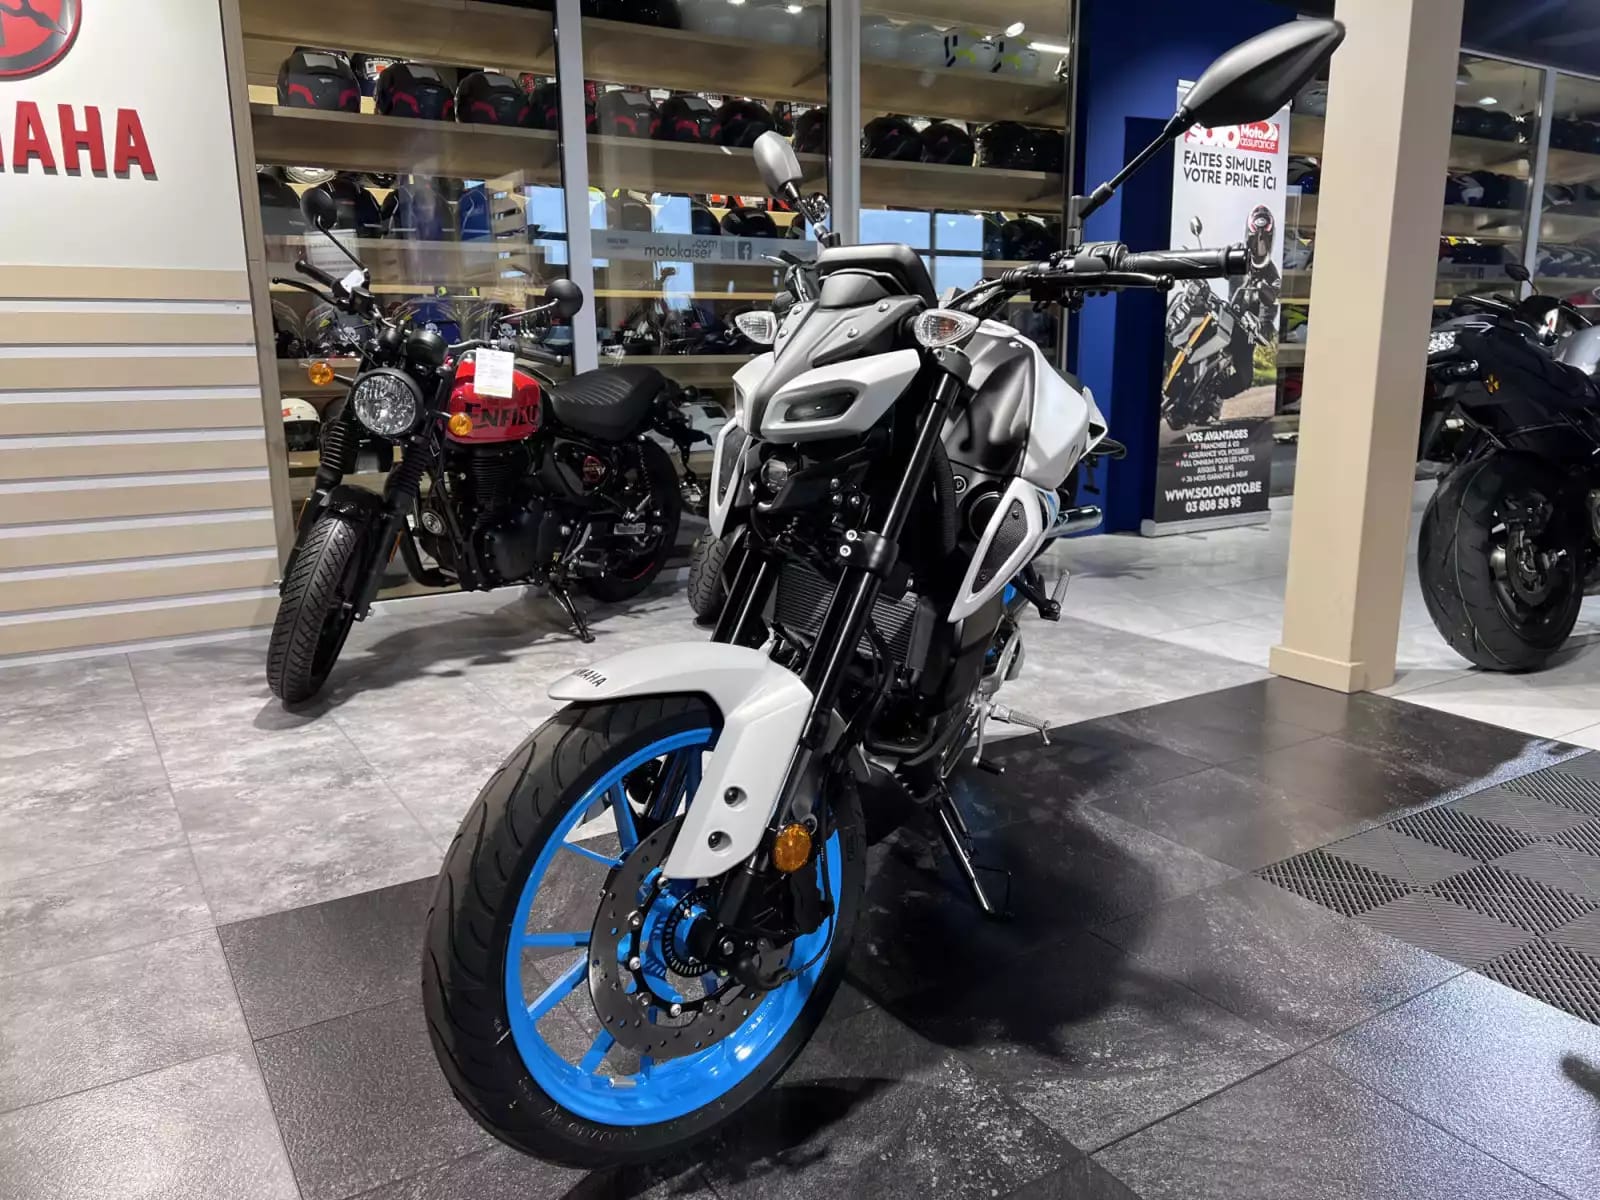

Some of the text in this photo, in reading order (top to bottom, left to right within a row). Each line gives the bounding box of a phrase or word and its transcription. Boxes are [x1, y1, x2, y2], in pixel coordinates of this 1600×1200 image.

[0, 100, 158, 181] AHA
[1183, 150, 1272, 174] FAITES SIMULER
[1183, 167, 1277, 190] VOTRE PRIME ICI
[644, 242, 712, 259] motokaiser
[1186, 429, 1249, 442] VOS AVANTAGES
[1215, 457, 1228, 465] POUR
[1165, 481, 1262, 502] WWW.SOLOMOTO.BE
[1185, 501, 1198, 513] 03
[1217, 498, 1229, 509] 58
[1230, 496, 1242, 508] 95
